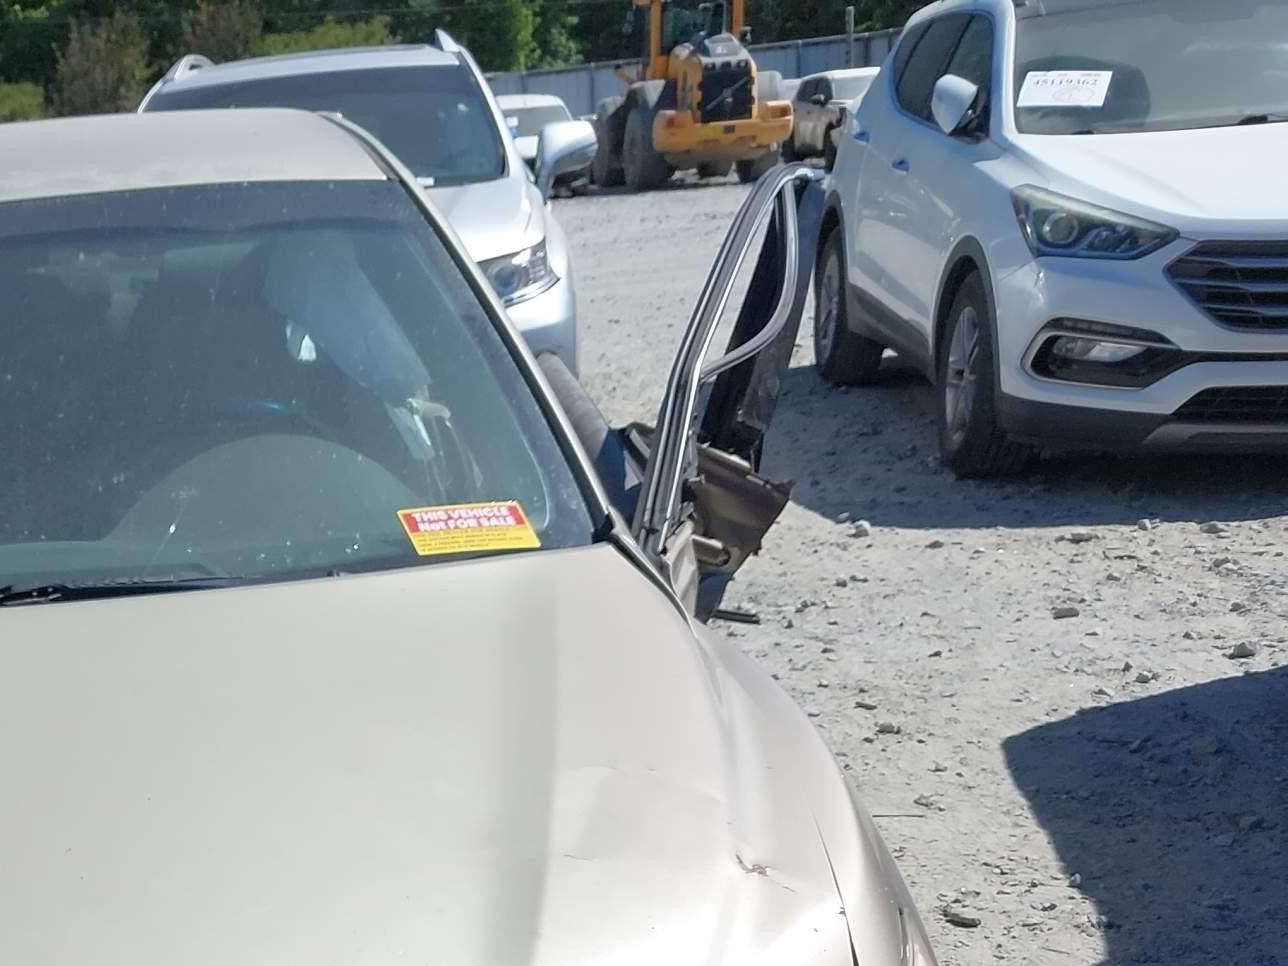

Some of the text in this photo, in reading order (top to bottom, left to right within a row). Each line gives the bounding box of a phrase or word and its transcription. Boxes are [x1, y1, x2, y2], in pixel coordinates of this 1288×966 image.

[412, 506, 510, 522] THIS VEHICLE
[418, 514, 516, 533] Not FOR SALE
